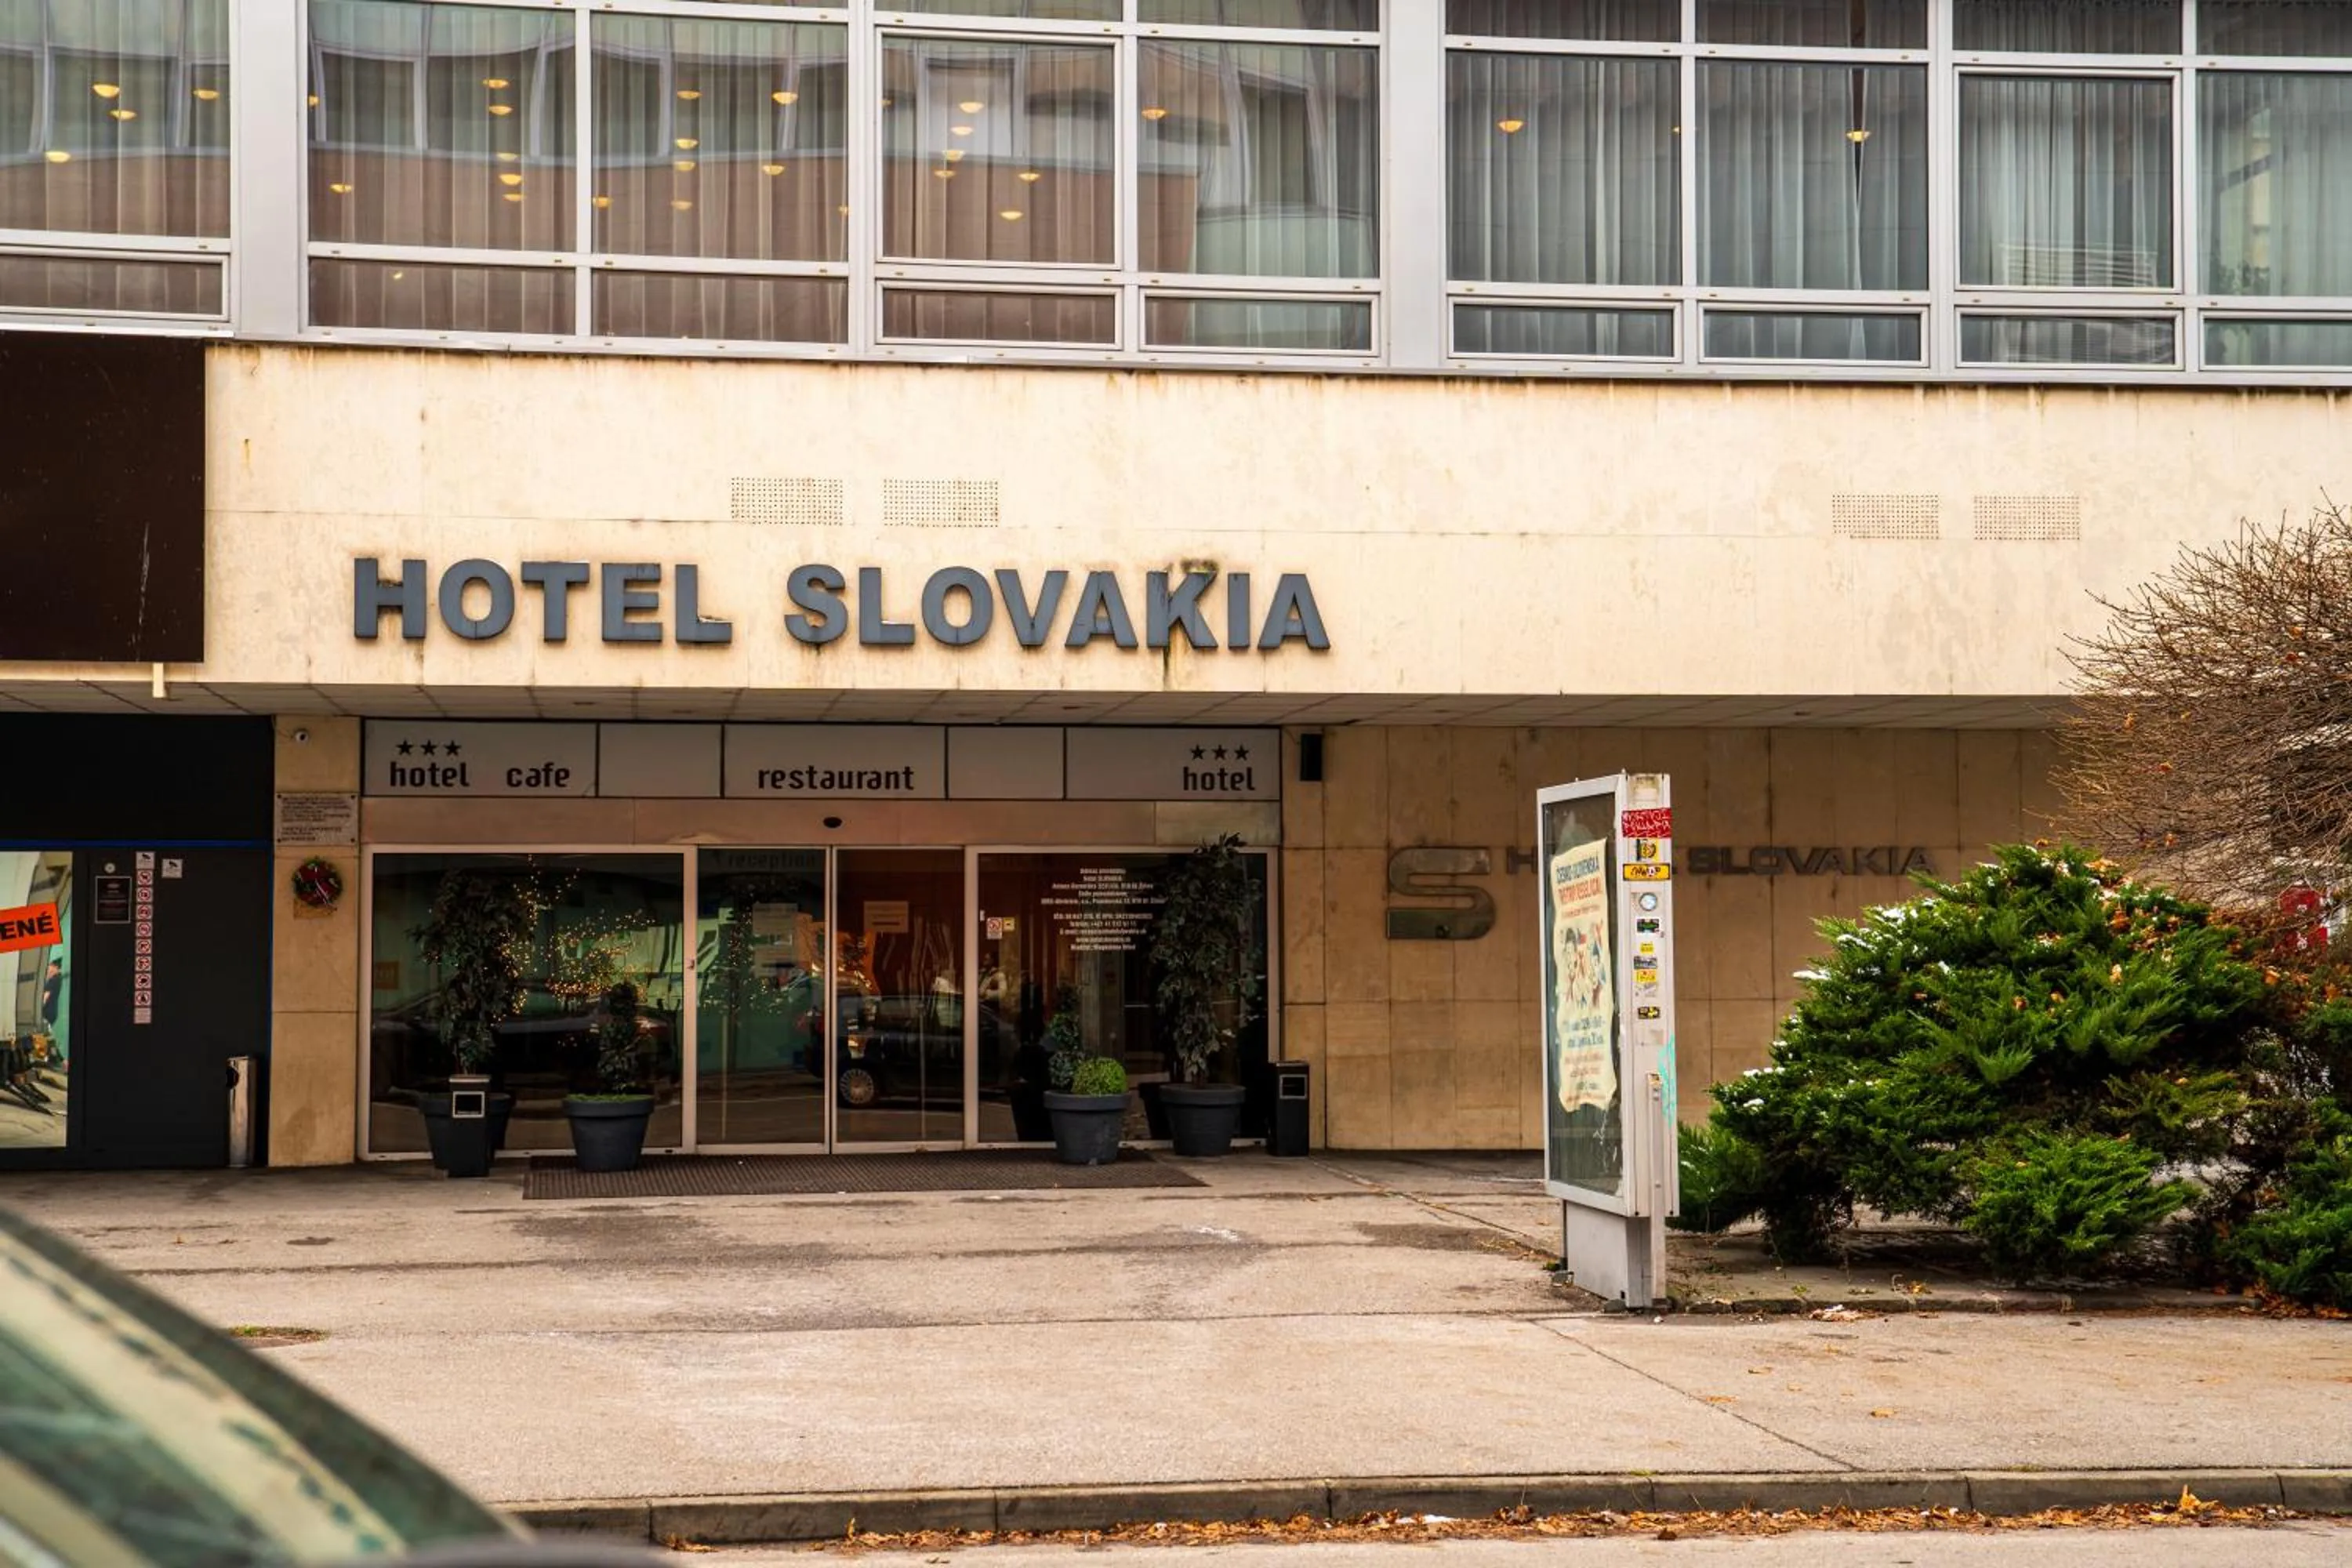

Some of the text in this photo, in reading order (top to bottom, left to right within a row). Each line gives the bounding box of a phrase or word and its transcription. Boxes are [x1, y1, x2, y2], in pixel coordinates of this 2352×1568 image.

[354, 557, 1331, 649] HOTEL SLOVAKIA
[390, 761, 571, 788] hotel cafe
[757, 765, 915, 790] restaurant
[1182, 766, 1256, 791] hotel
[1688, 846, 1938, 876] SLOVAKIA
